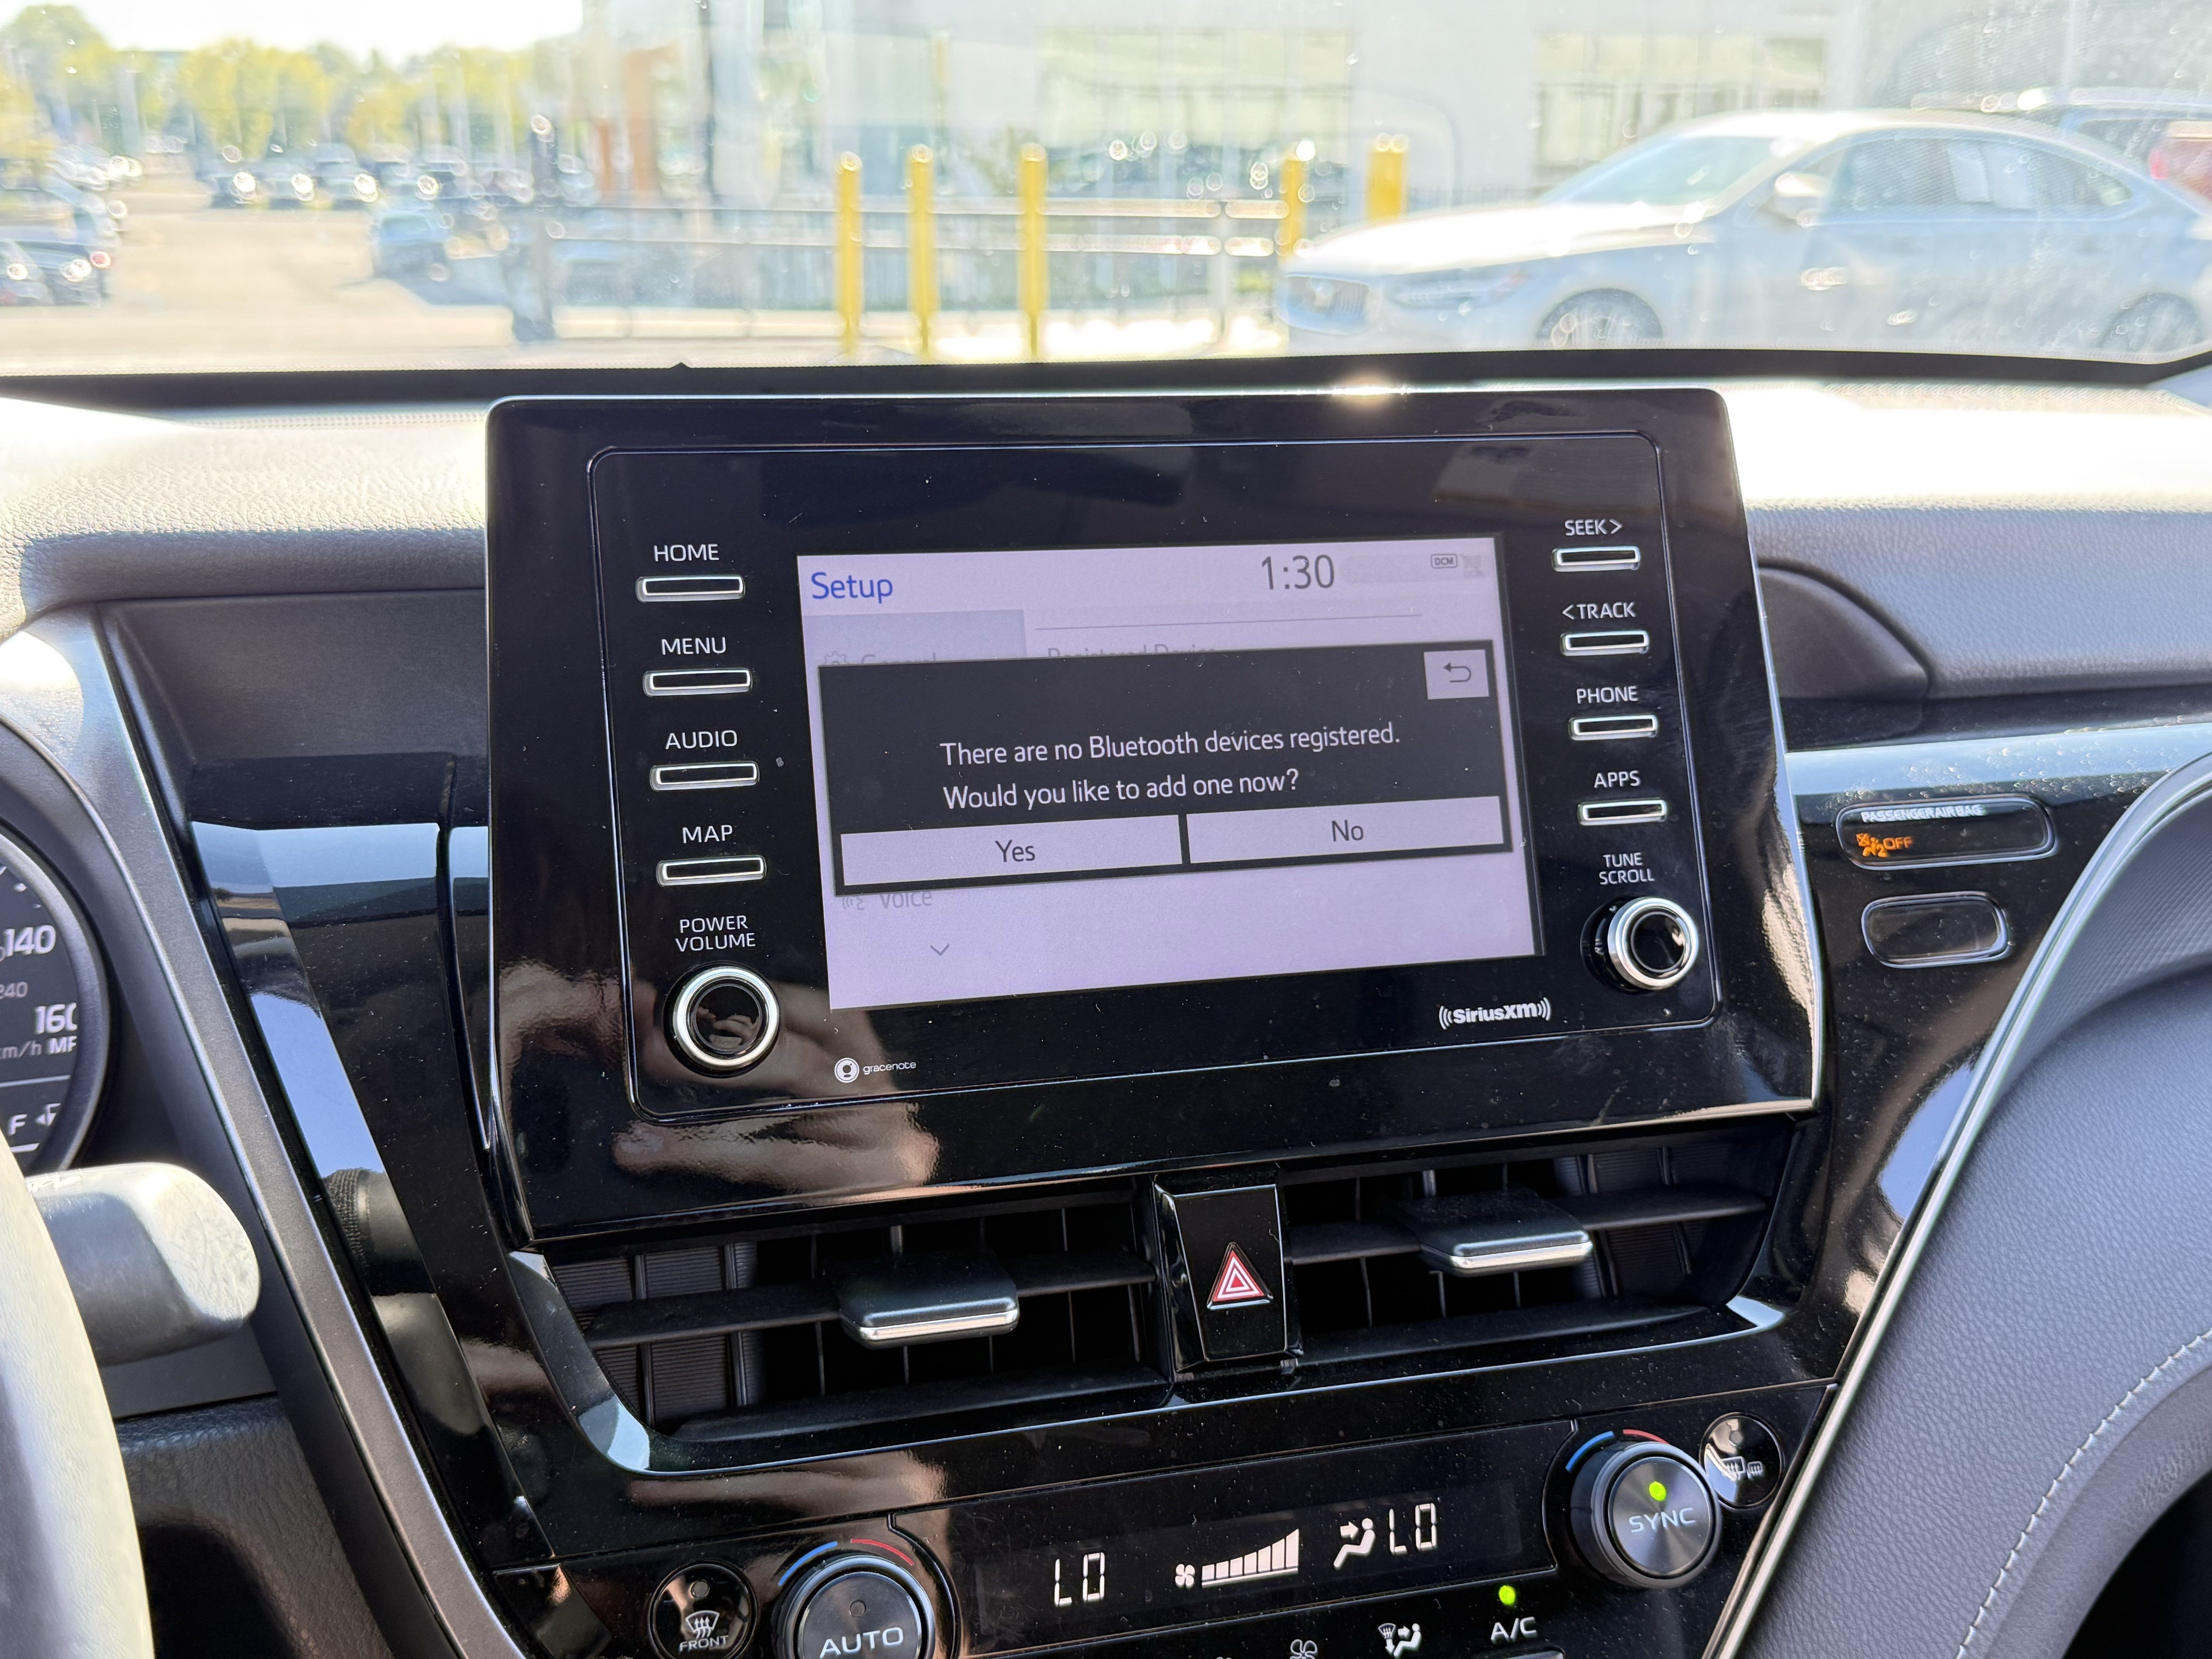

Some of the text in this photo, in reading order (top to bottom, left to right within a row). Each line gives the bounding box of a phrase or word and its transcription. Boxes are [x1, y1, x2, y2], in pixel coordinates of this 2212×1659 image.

[654, 544, 720, 562] HOME
[1434, 557, 1453, 565] DCM
[1262, 555, 1334, 590] 1:30
[811, 572, 893, 603] Setup
[662, 637, 726, 655] MENU
[1577, 685, 1640, 704] PHONE
[666, 730, 737, 750] AUDIO
[940, 721, 1400, 766] There are no Bluetooth devices registered.
[943, 768, 1299, 810] Would you like to add one now?
[1594, 771, 1641, 788] APPS
[1861, 804, 1985, 823] PASSENGER AIR BAG
[682, 825, 733, 843] MAP
[1331, 820, 1364, 842] No
[995, 840, 1036, 863] Yes
[1883, 836, 1913, 850] OFF
[1603, 852, 1644, 868] TUNE
[1599, 868, 1655, 884] SCROLL
[680, 915, 748, 933] POWER
[3, 924, 56, 957] 140
[675, 933, 756, 952] VOLUME
[0, 1040, 42, 1060] m/h
[863, 1061, 917, 1075] gracenote
[8, 1114, 27, 1136] F
[1629, 1508, 1697, 1533] SYNC
[1491, 1616, 1538, 1644] A/C
[678, 1635, 729, 1653] FRONT
[819, 1626, 904, 1659] AUTO
